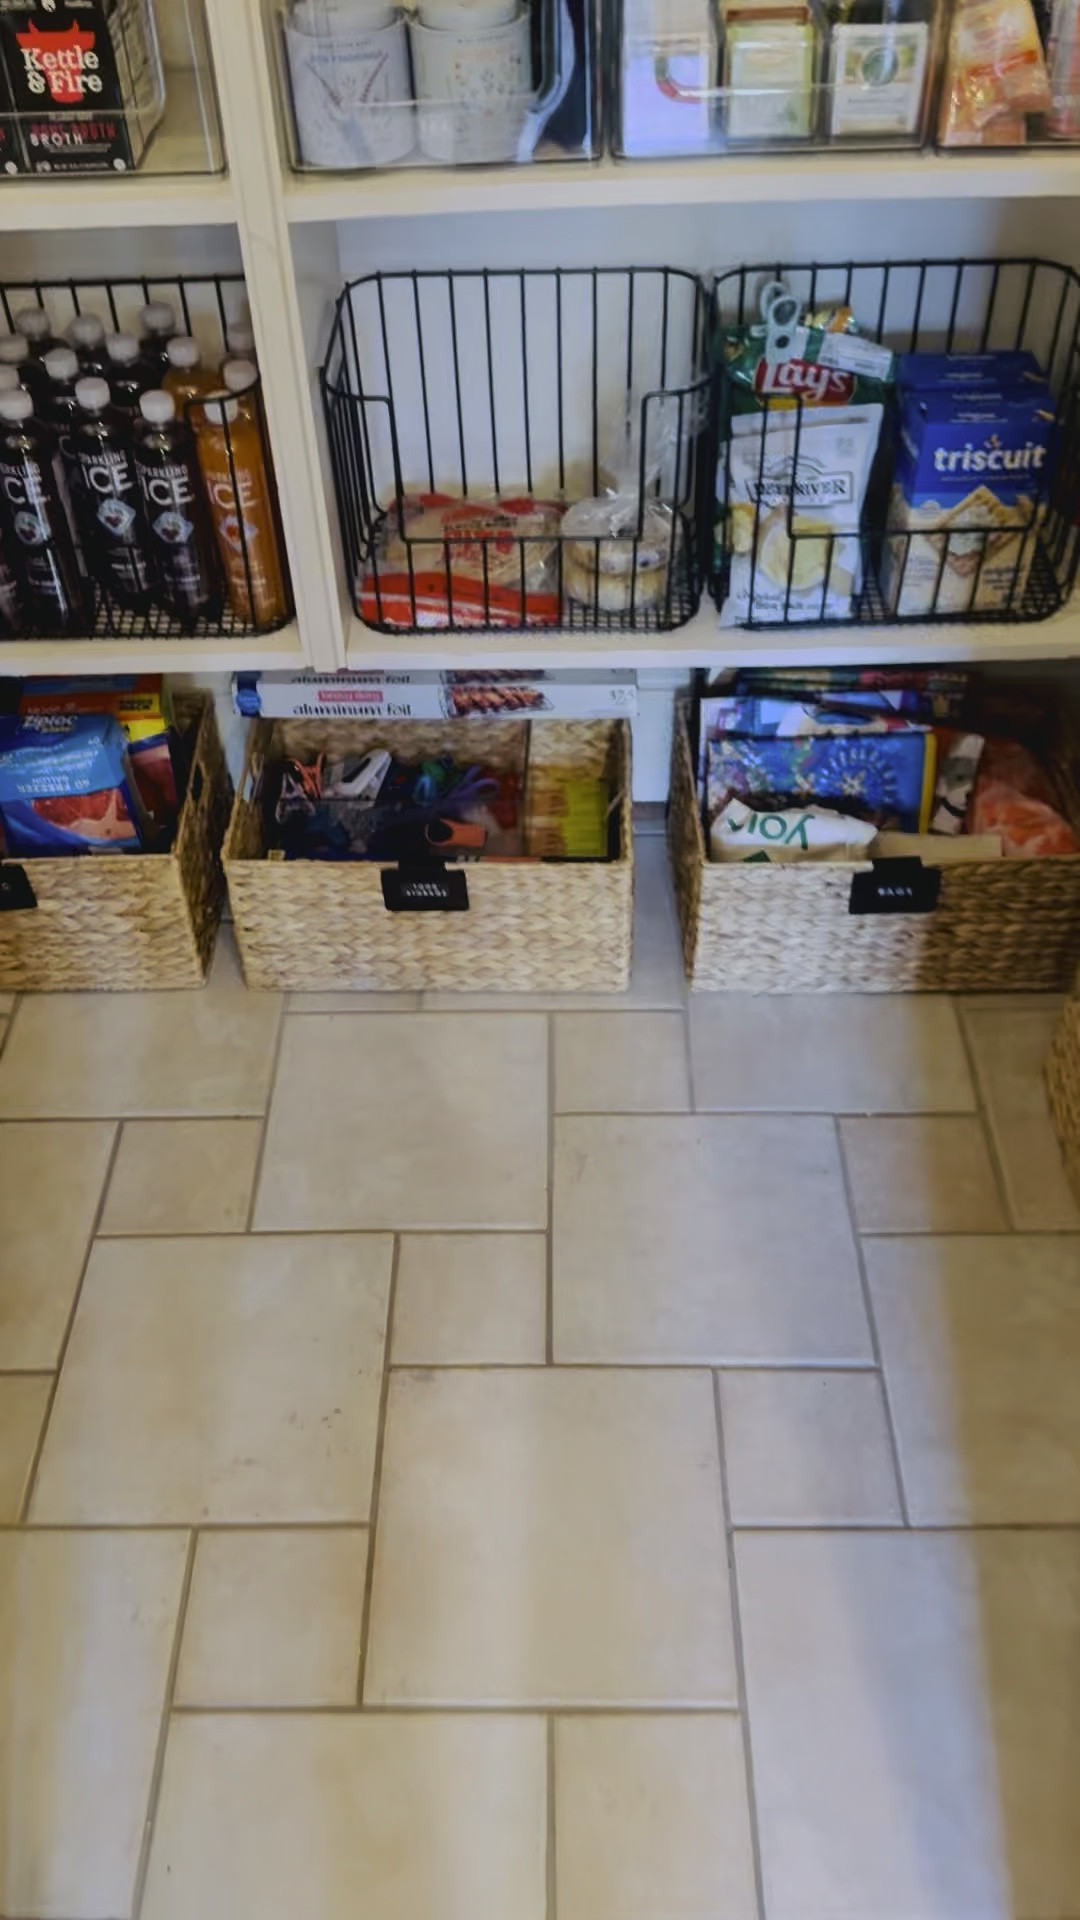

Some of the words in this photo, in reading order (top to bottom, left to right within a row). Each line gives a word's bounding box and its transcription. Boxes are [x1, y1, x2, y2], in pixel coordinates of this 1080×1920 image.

[20, 45, 99, 70] Kettle
[27, 71, 45, 94] &
[48, 70, 103, 93] Fire
[934, 442, 1047, 472] triscuit
[81, 463, 133, 493] ICE
[142, 475, 194, 505] ICE
[292, 703, 382, 716] aluminum
[386, 703, 412, 716] foil
